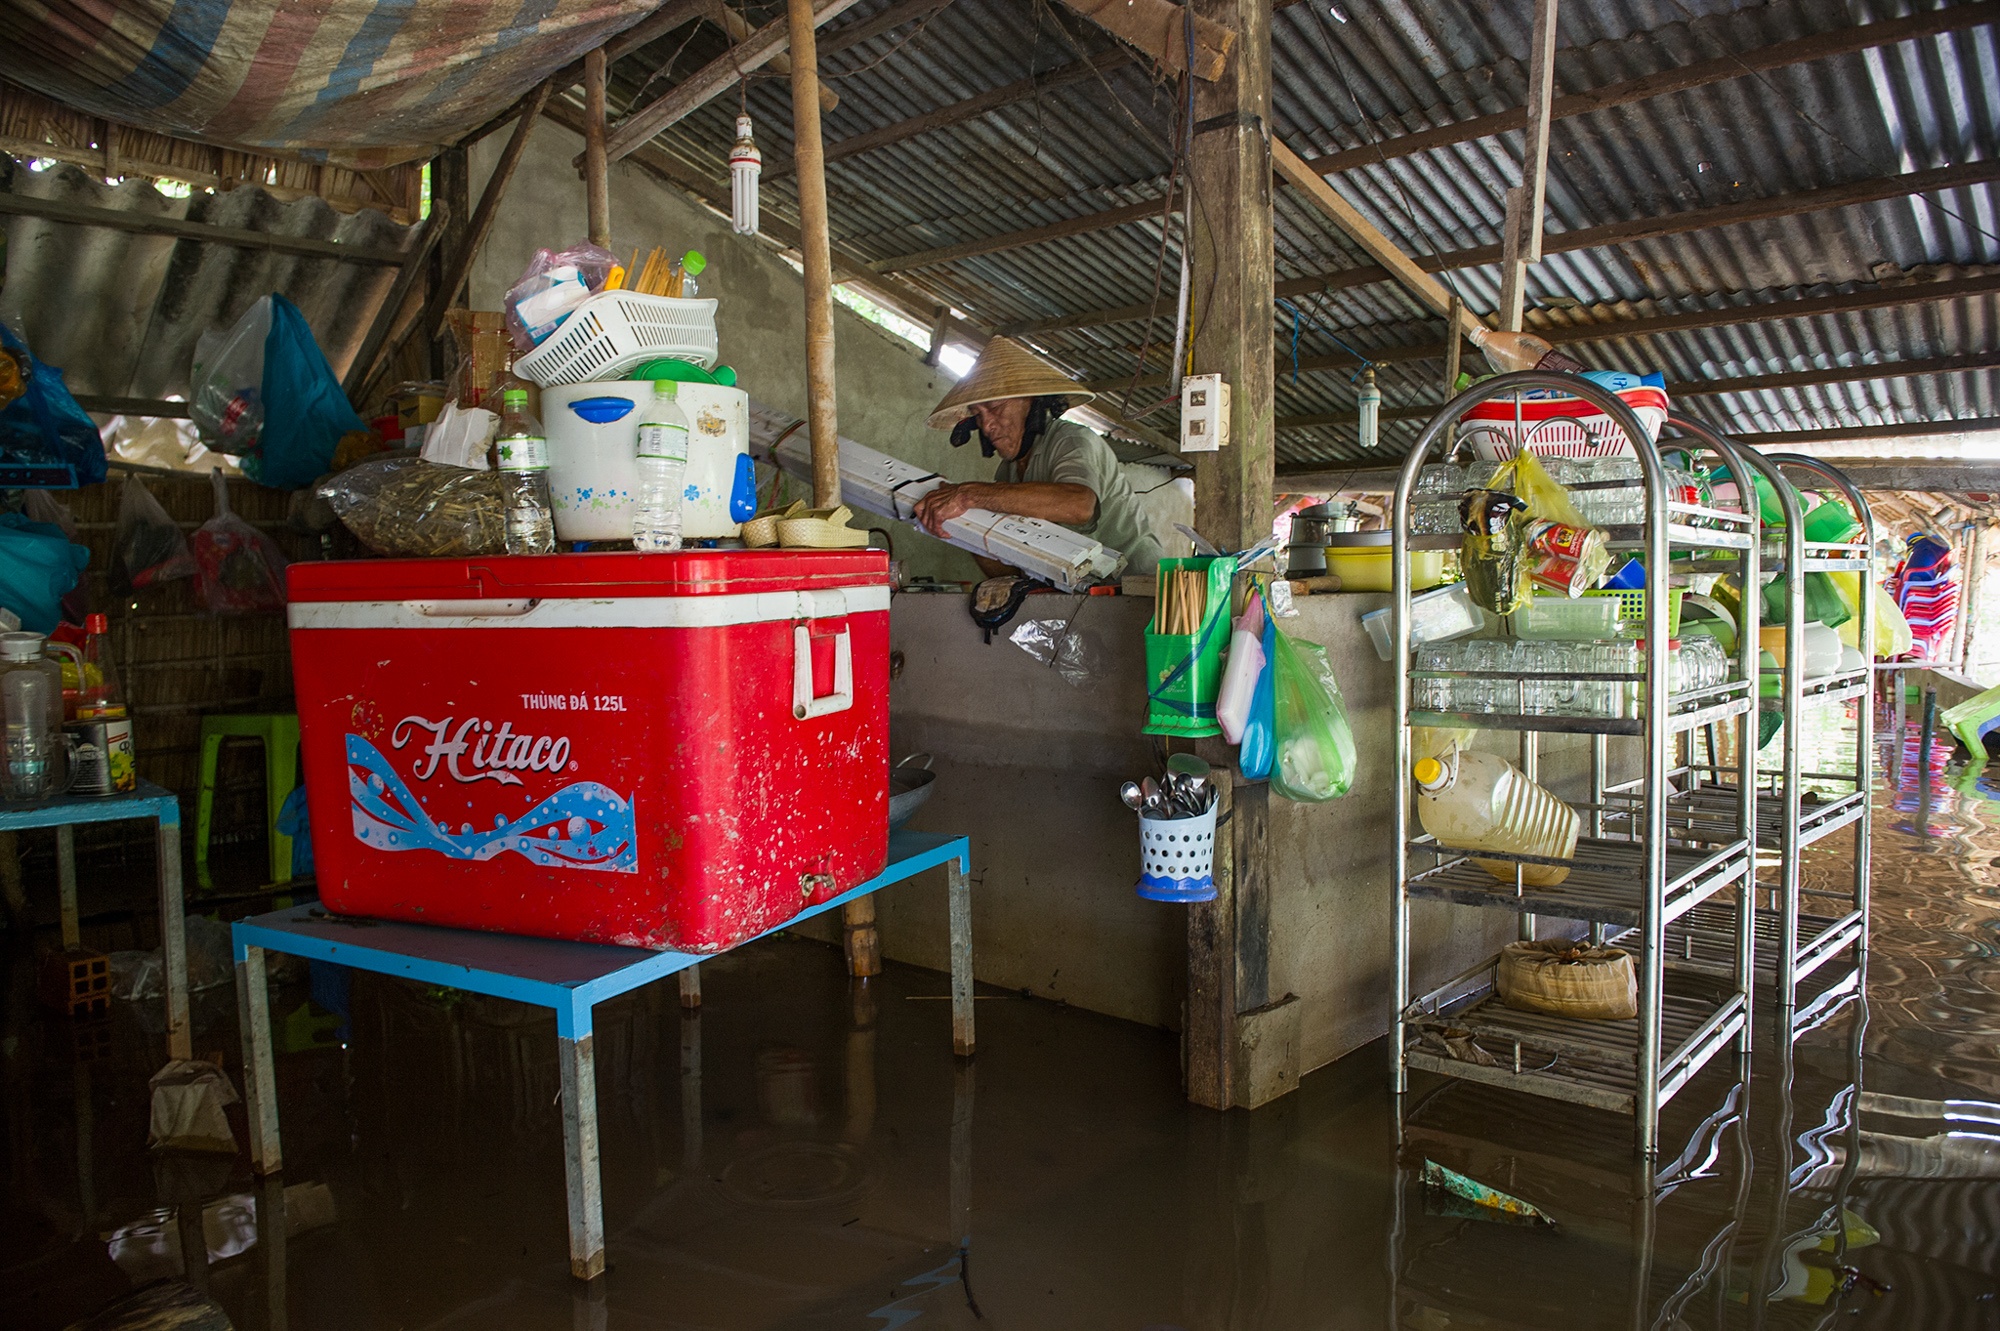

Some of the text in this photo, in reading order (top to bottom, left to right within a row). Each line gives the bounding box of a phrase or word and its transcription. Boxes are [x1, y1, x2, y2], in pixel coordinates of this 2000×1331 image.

[520, 690, 628, 712] THÙNG ĐÁ 125L
[391, 715, 571, 786] Hitaco
